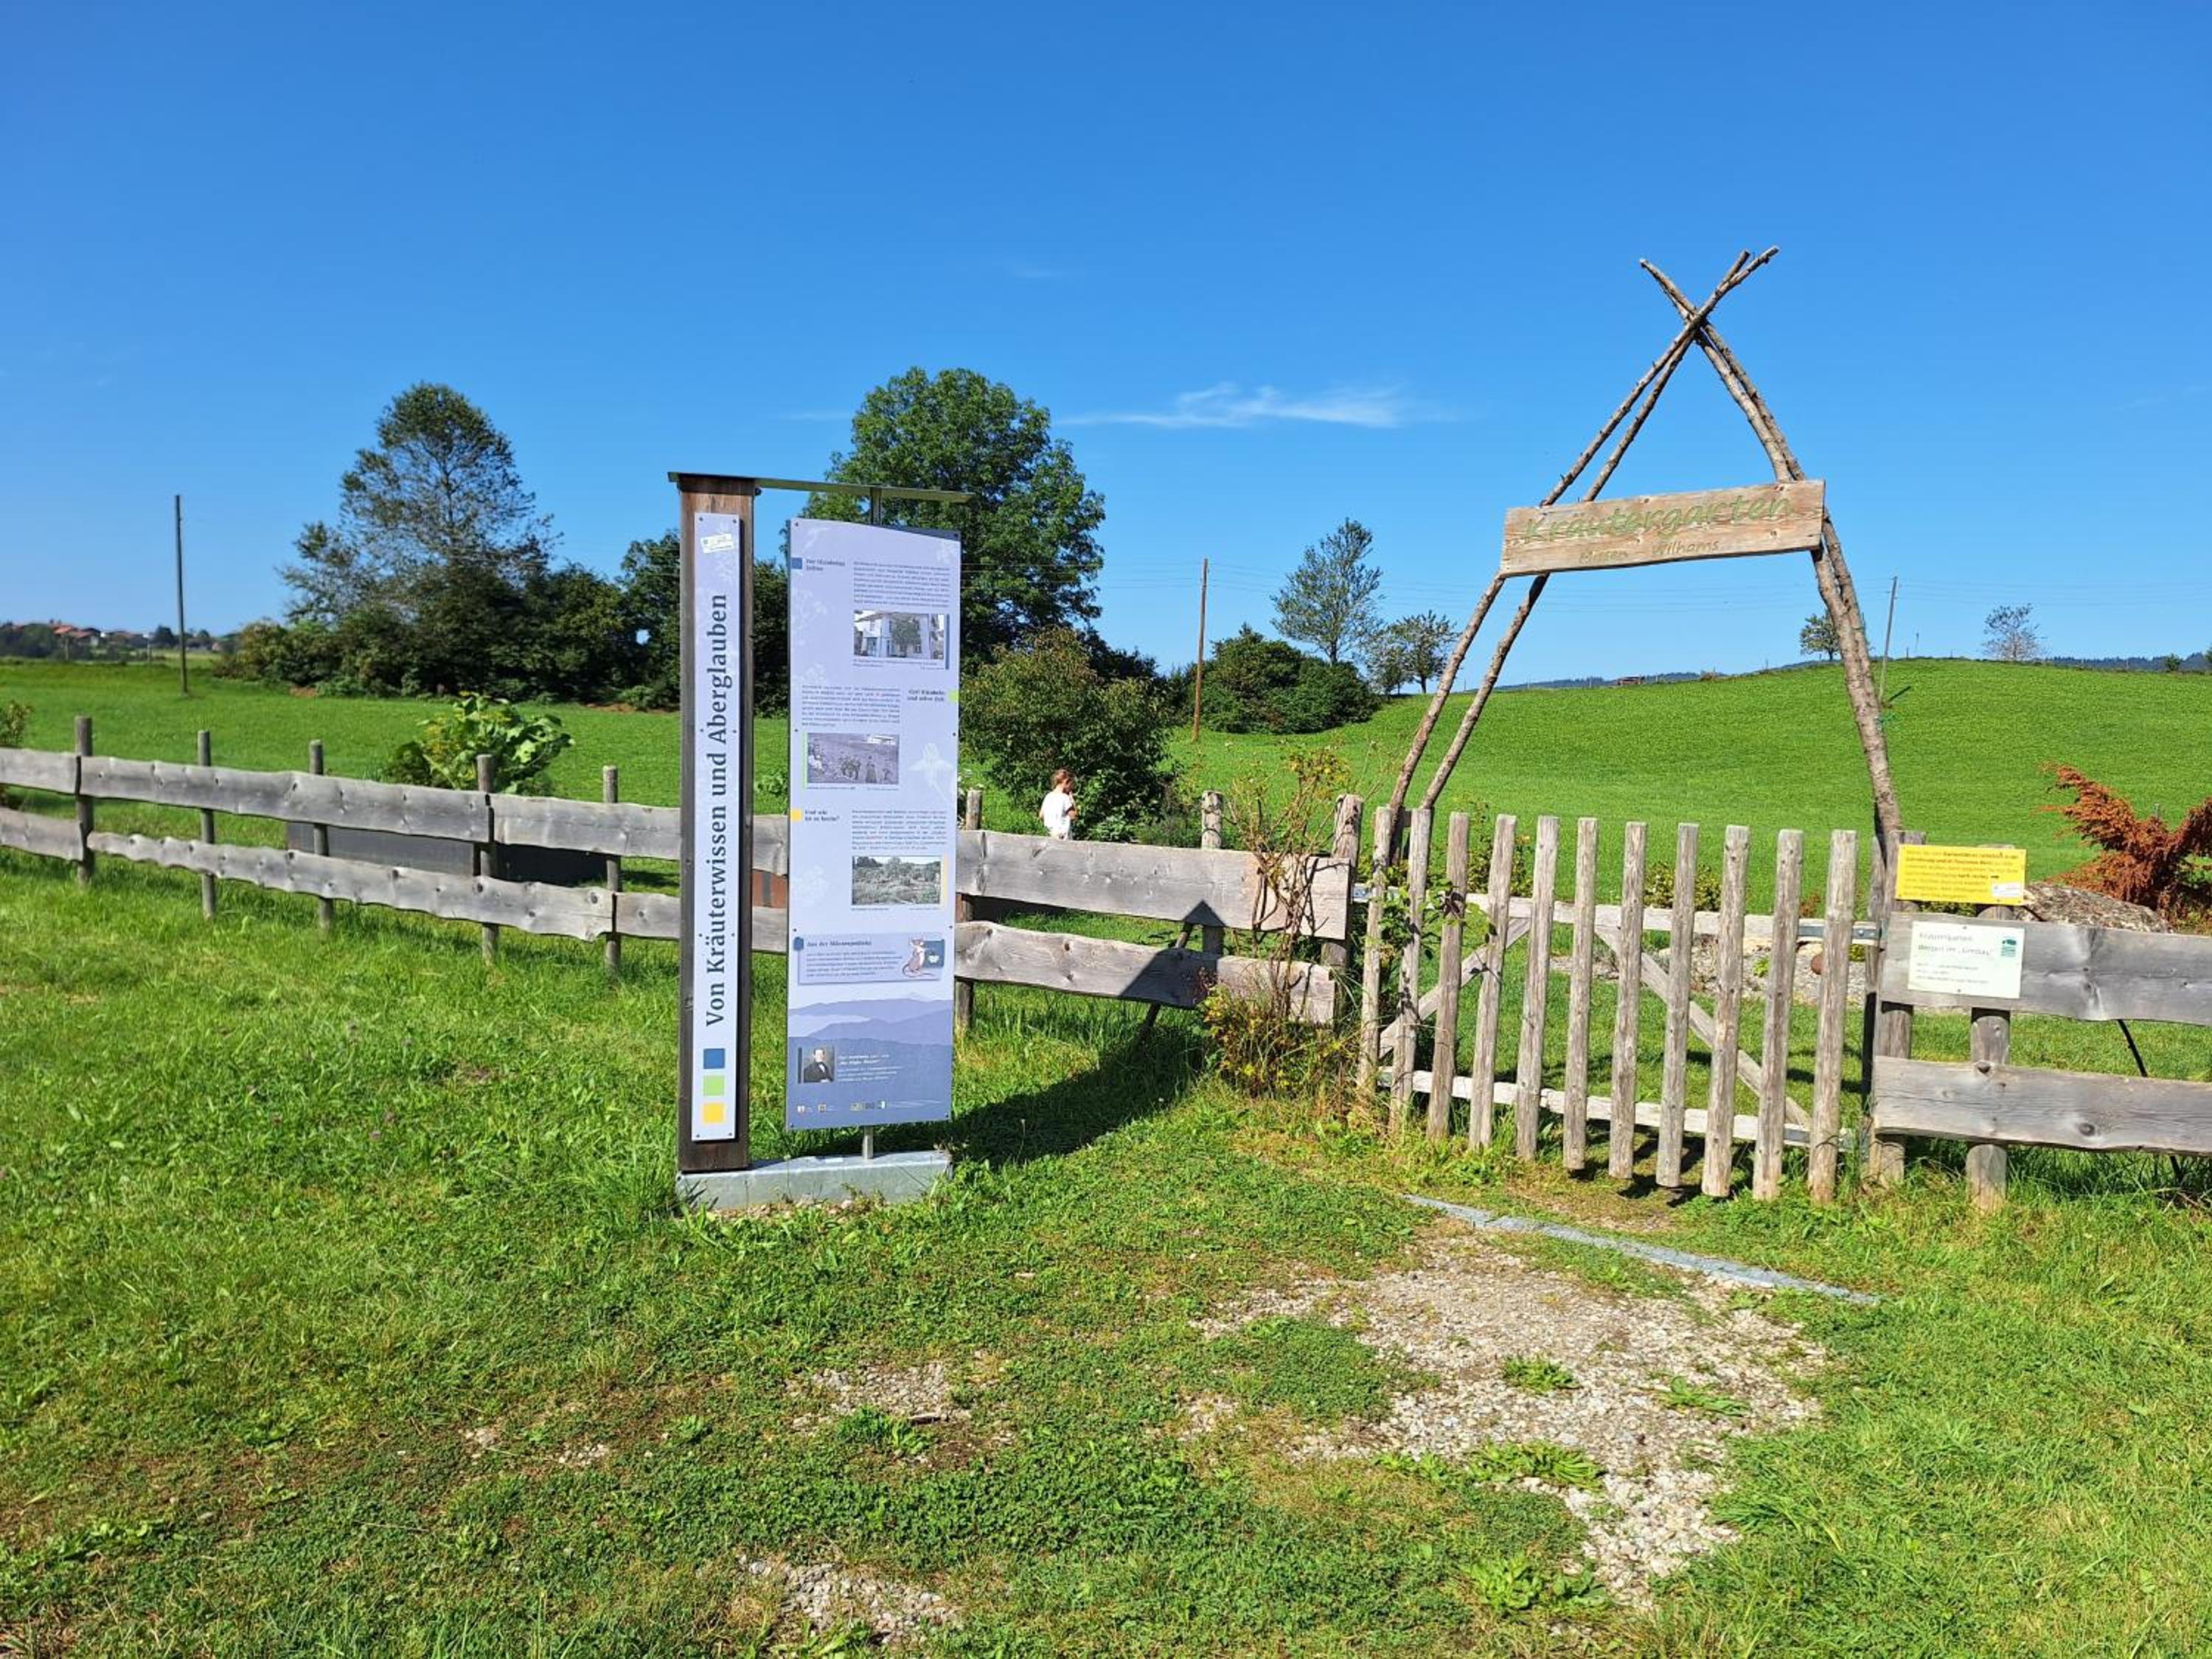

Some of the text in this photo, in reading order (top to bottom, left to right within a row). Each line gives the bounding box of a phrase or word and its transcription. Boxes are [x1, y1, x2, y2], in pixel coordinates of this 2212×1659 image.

[1520, 495, 1795, 543] Kräutergarten
[706, 594, 731, 1026] Von Kräuterwissen und Aberglauben
